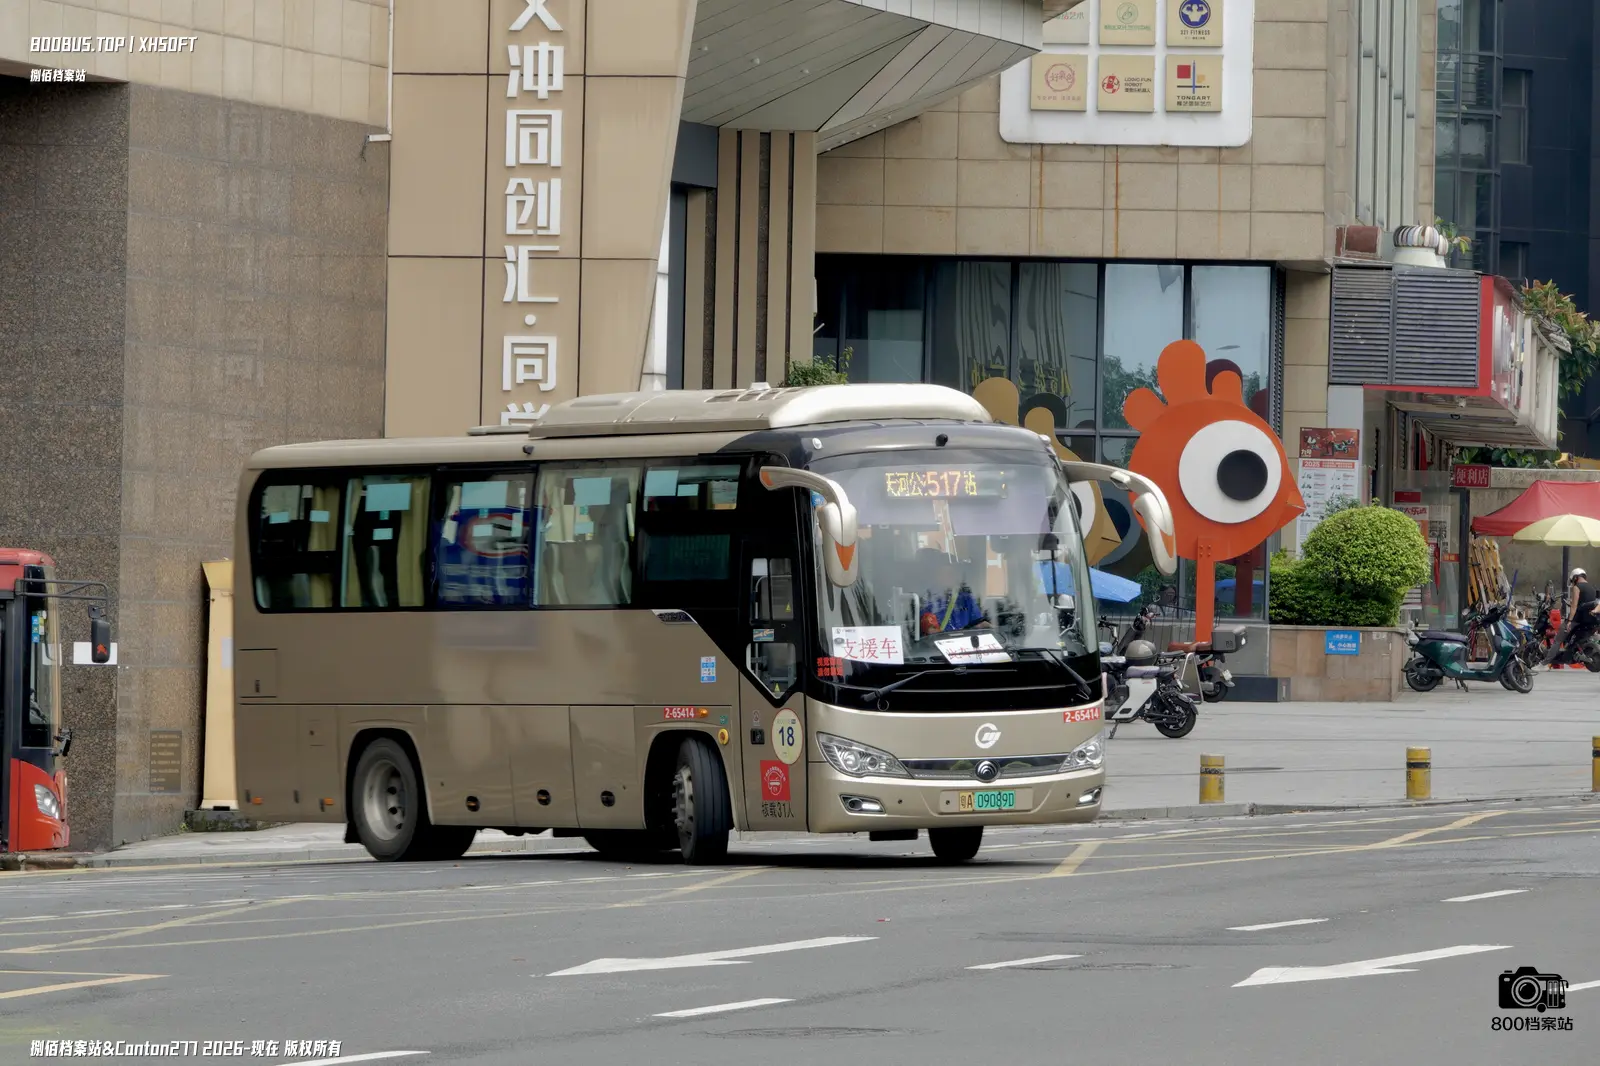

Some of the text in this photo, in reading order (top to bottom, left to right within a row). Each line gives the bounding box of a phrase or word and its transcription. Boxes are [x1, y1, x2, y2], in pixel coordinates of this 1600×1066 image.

[1456, 468, 1488, 485] 便利店
[843, 637, 899, 660] 支援车
[665, 707, 695, 719] 2-65414
[1065, 709, 1099, 722] 2-65414
[778, 726, 795, 747] 18
[977, 791, 1015, 808] 09089D
